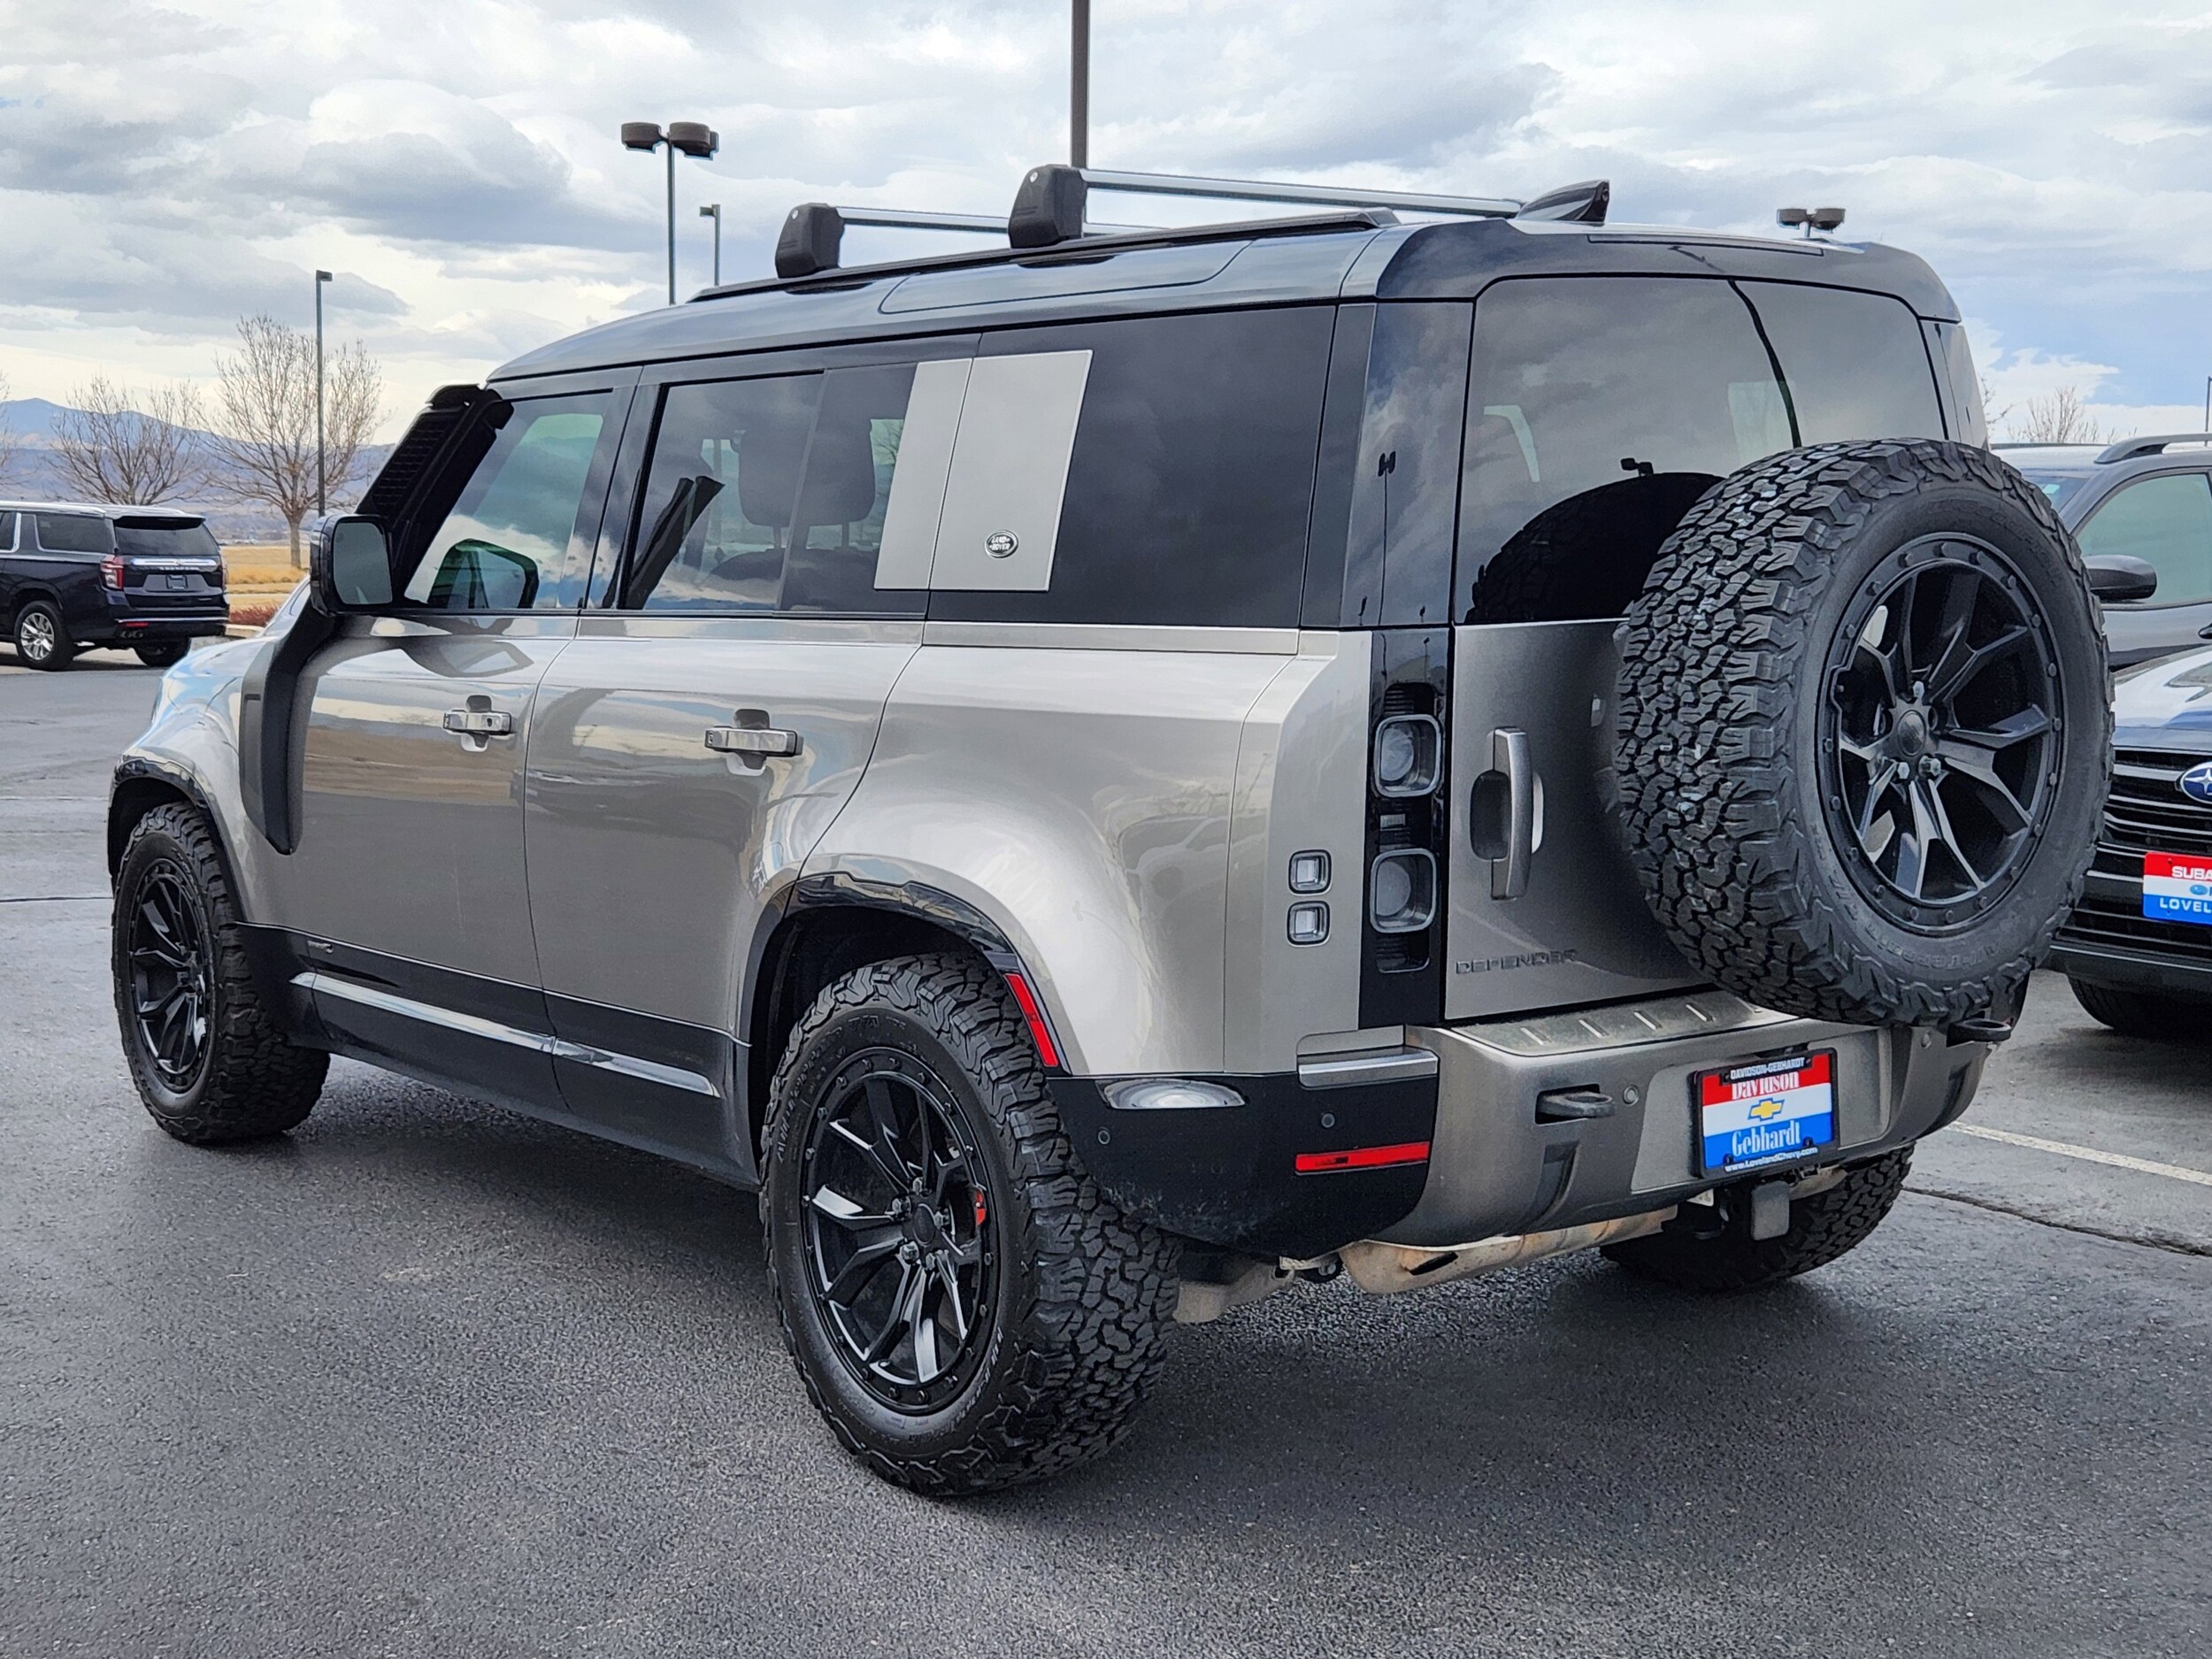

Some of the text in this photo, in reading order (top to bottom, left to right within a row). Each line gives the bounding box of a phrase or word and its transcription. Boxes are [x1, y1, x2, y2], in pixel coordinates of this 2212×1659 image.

[2160, 897, 2212, 913] LOVEL
[1456, 949, 1578, 974] DEFENDER
[1730, 1057, 1805, 1080] DAVIDSON-GEBHARDT
[1732, 1119, 1801, 1157] Gebhardt
